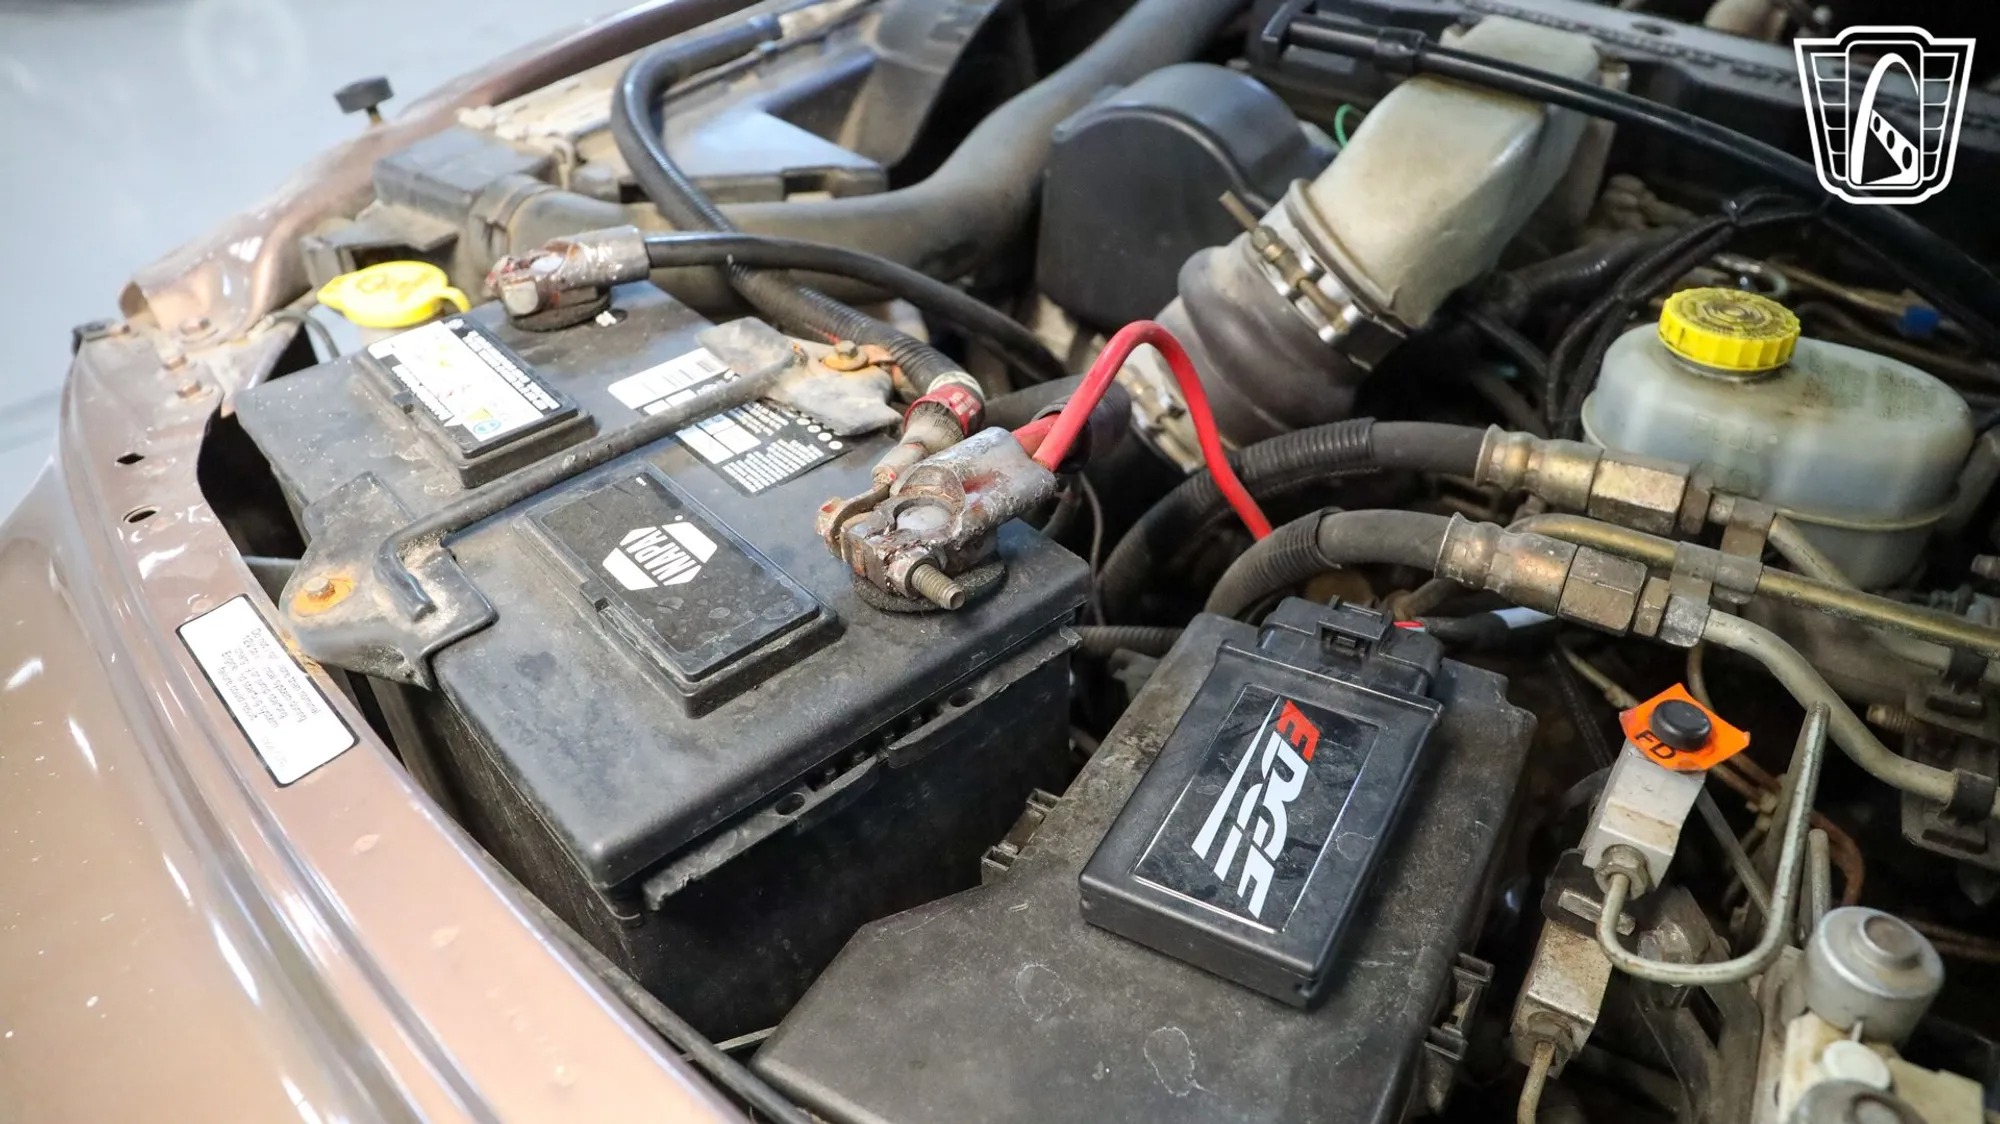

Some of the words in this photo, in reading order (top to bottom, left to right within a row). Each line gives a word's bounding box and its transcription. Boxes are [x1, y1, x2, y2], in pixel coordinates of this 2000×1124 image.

[626, 530, 697, 581] NAPA
[1635, 729, 1676, 759] FD
[1213, 699, 1321, 919] EDGE
